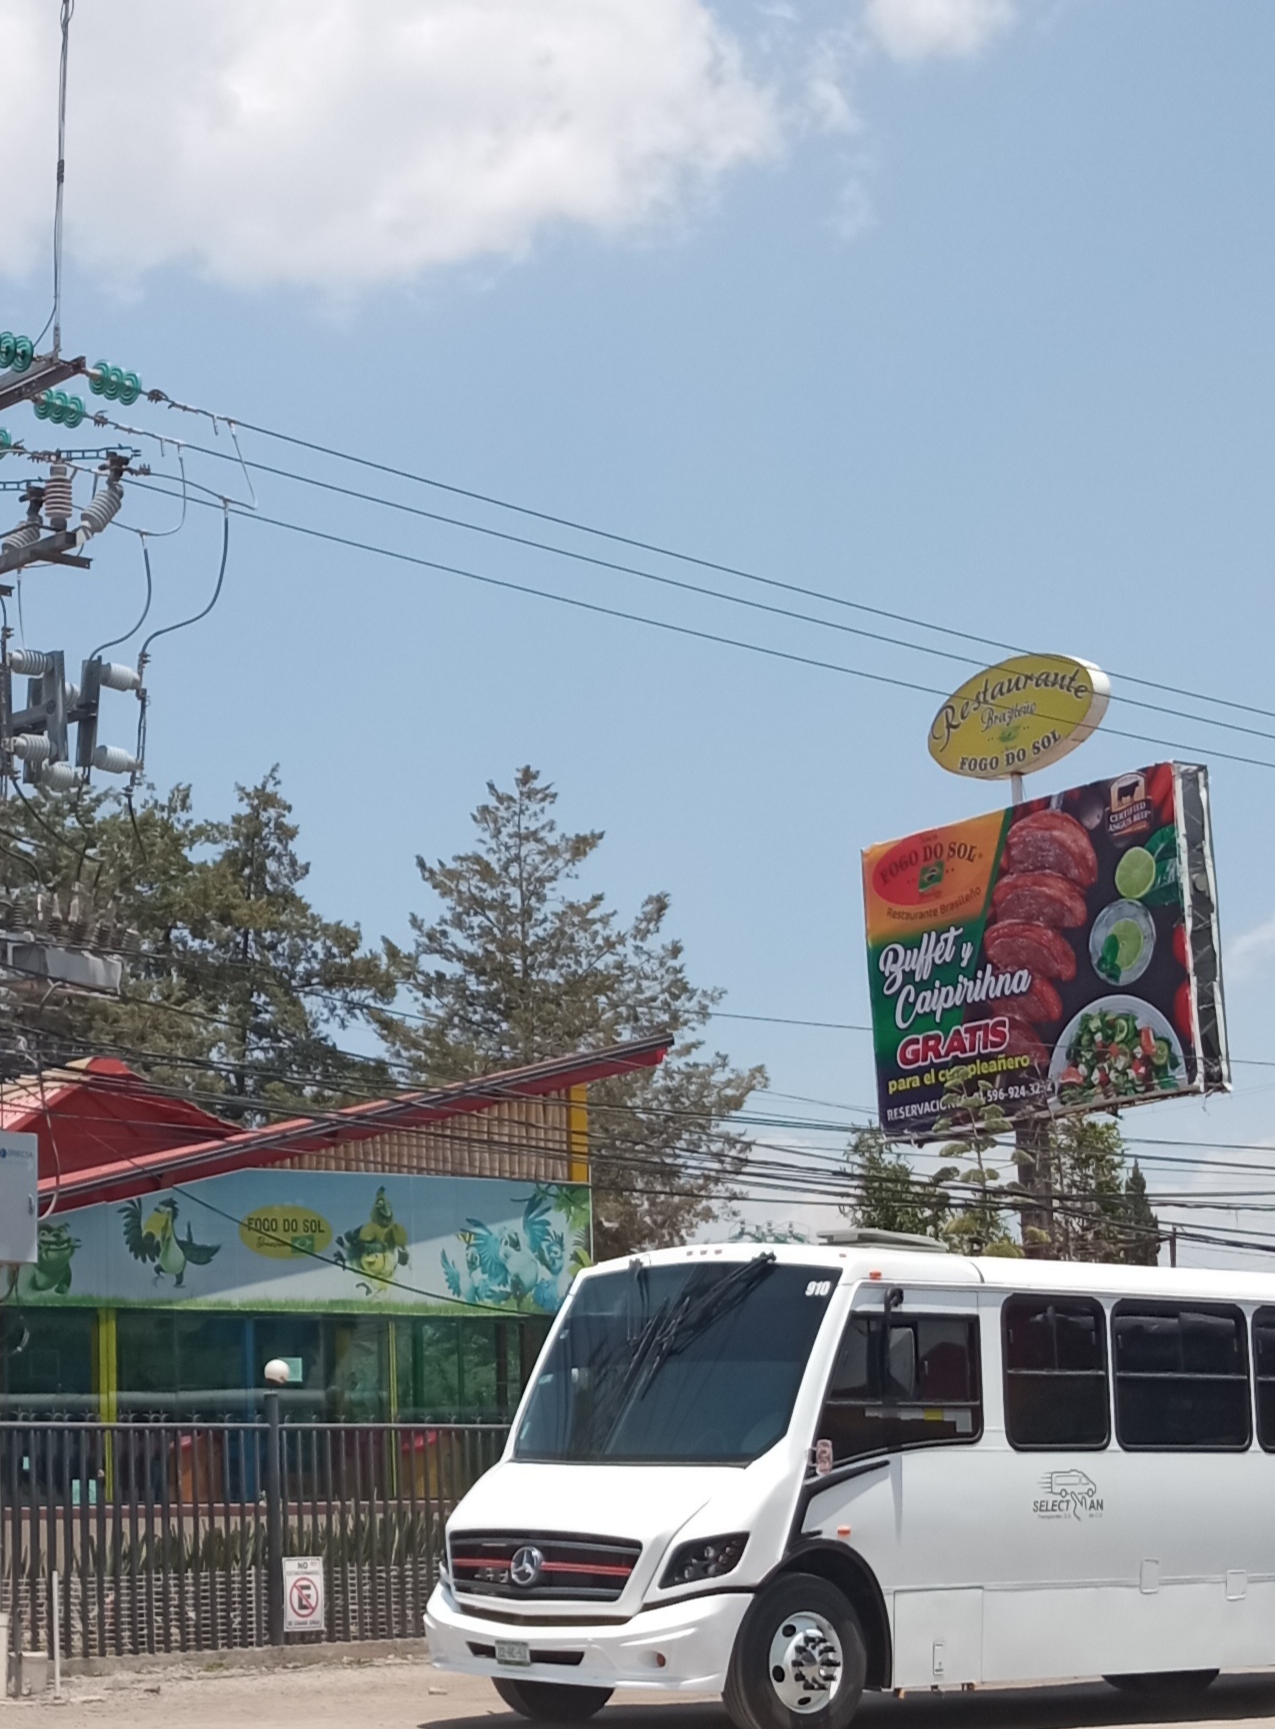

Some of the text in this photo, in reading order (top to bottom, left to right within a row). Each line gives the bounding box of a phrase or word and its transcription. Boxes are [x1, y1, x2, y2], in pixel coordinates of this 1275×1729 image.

[931, 668, 1088, 753] Restaurante
[959, 755, 999, 771] FOGO
[1005, 747, 1026, 766] DO
[1032, 728, 1061, 755] SOL
[879, 841, 977, 885] FOGO DO SOL
[886, 907, 938, 920] Restaurante
[939, 886, 982, 915] Brasileño
[879, 926, 973, 995] Buffet y
[895, 963, 1032, 1029] Caipirihna
[897, 1016, 1009, 1069] GRATIS
[888, 1075, 921, 1095] para
[924, 1069, 935, 1085] el
[247, 1217, 326, 1233] FOGO DO SOL
[805, 1281, 831, 1296] 910
[1033, 1500, 1071, 1513] SELECT
[297, 1562, 309, 1570] NO
